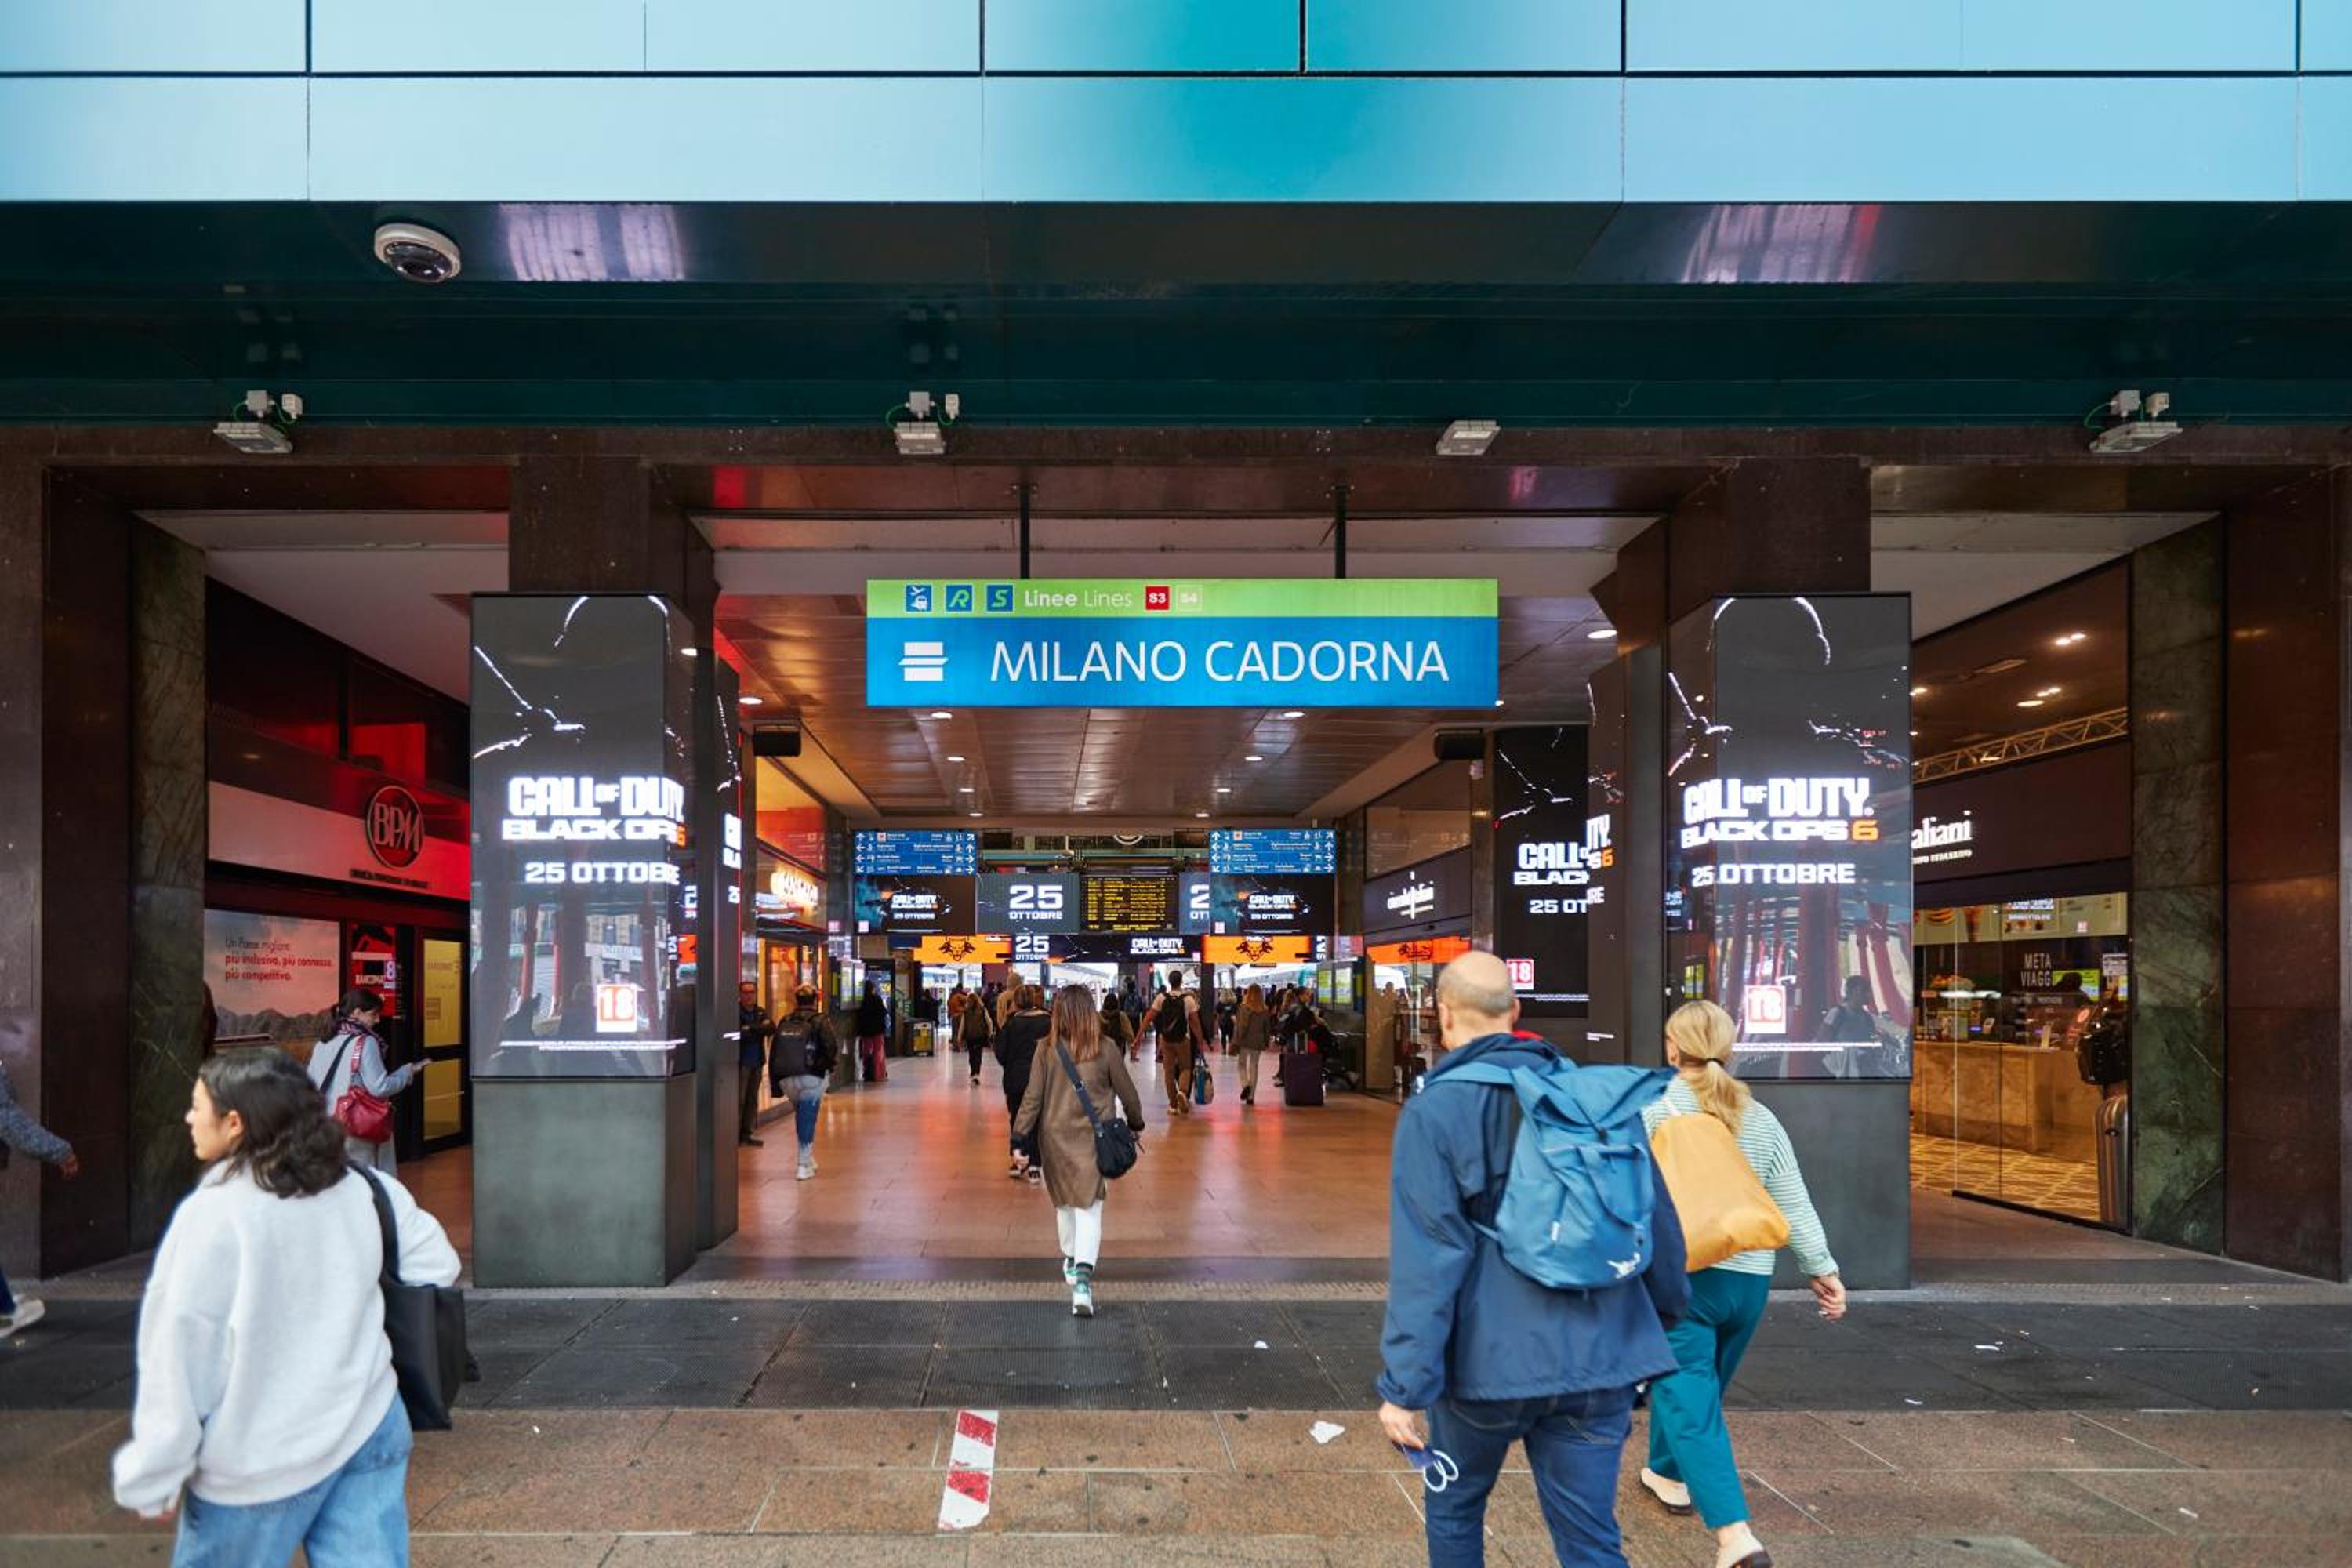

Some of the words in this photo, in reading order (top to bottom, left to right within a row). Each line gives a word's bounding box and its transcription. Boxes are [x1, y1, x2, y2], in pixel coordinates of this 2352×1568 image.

[1025, 590, 1077, 607] Linee
[1084, 590, 1132, 608] Lines
[1149, 593, 1166, 604] S3
[990, 641, 1186, 681] MILANO
[1205, 641, 1450, 681] CADORNA
[508, 777, 601, 816] CALL
[595, 784, 620, 803] OF
[1683, 778, 1748, 825] CALL
[1742, 786, 1767, 804] OF
[374, 802, 419, 853] BPM
[502, 819, 622, 840] BLACK
[677, 826, 686, 846] 6
[1681, 821, 1769, 849] BLACK
[1772, 820, 1848, 840] OPS
[1852, 820, 1878, 841] 6
[1911, 810, 1973, 849] aliani
[1519, 842, 1584, 869] CALL
[1602, 848, 1613, 867] 6
[525, 862, 565, 883] 25
[1692, 866, 1715, 887] 25
[1718, 863, 1856, 884] OTTOBRE
[1009, 885, 1063, 909] 25
[1530, 899, 1558, 913] 25
[1008, 910, 1063, 920] OTTOBRE
[1015, 935, 1049, 953] 25
[1508, 963, 1531, 982] 18
[601, 987, 633, 1020] 18
[1749, 990, 1782, 1020] 18
